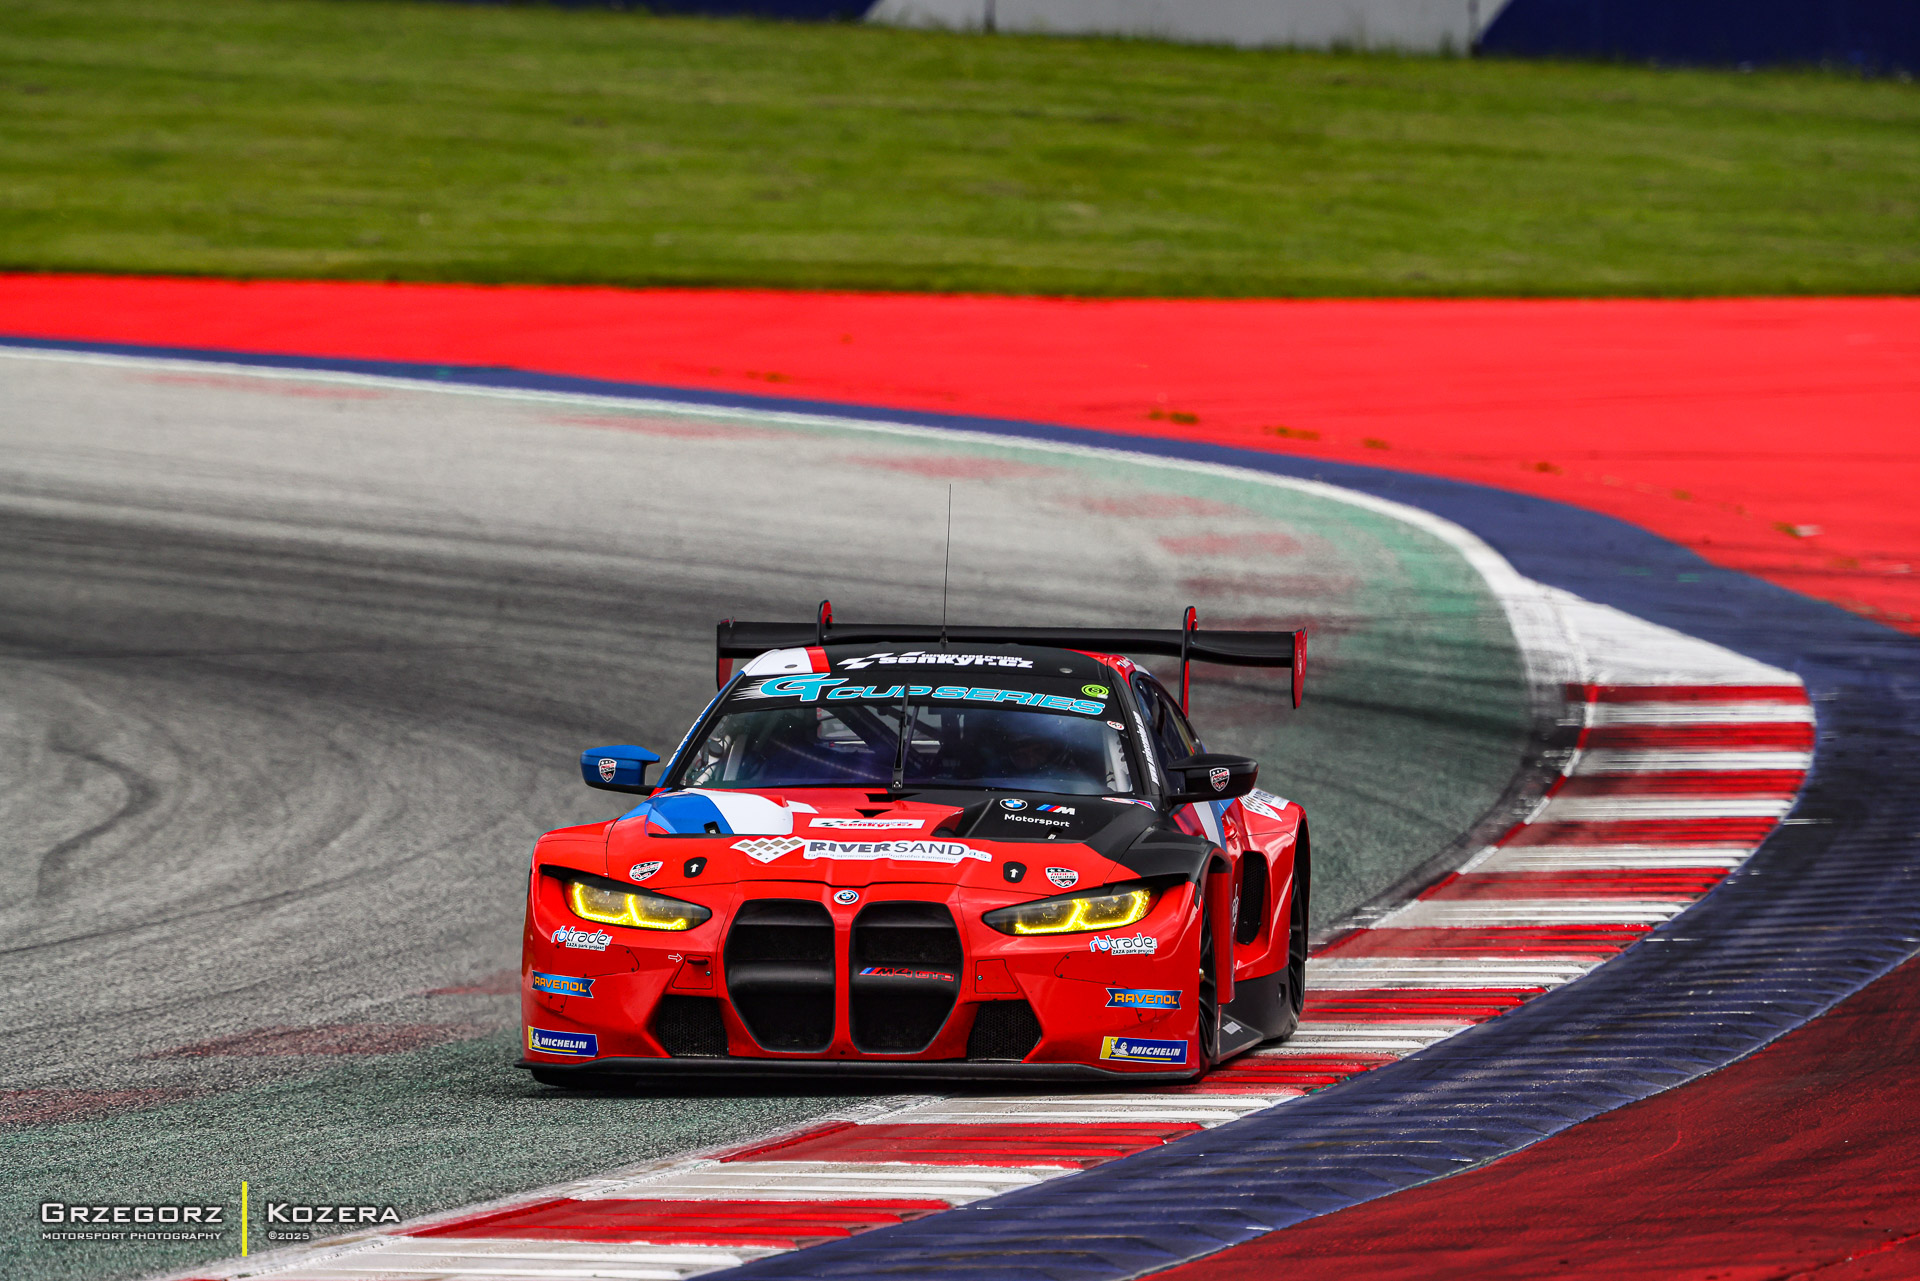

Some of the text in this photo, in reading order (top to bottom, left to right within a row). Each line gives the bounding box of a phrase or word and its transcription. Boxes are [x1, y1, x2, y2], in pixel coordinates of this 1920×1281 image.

[759, 673, 1105, 715] GT CUP SERIES
[1004, 814, 1070, 827] Motorsport
[809, 841, 965, 856] RIVERSAND
[534, 976, 587, 993] RAVENOL
[1114, 993, 1177, 1005] RAVENOL
[540, 1037, 587, 1049] MICHELIN
[1130, 1045, 1181, 1057] MICHELIN
